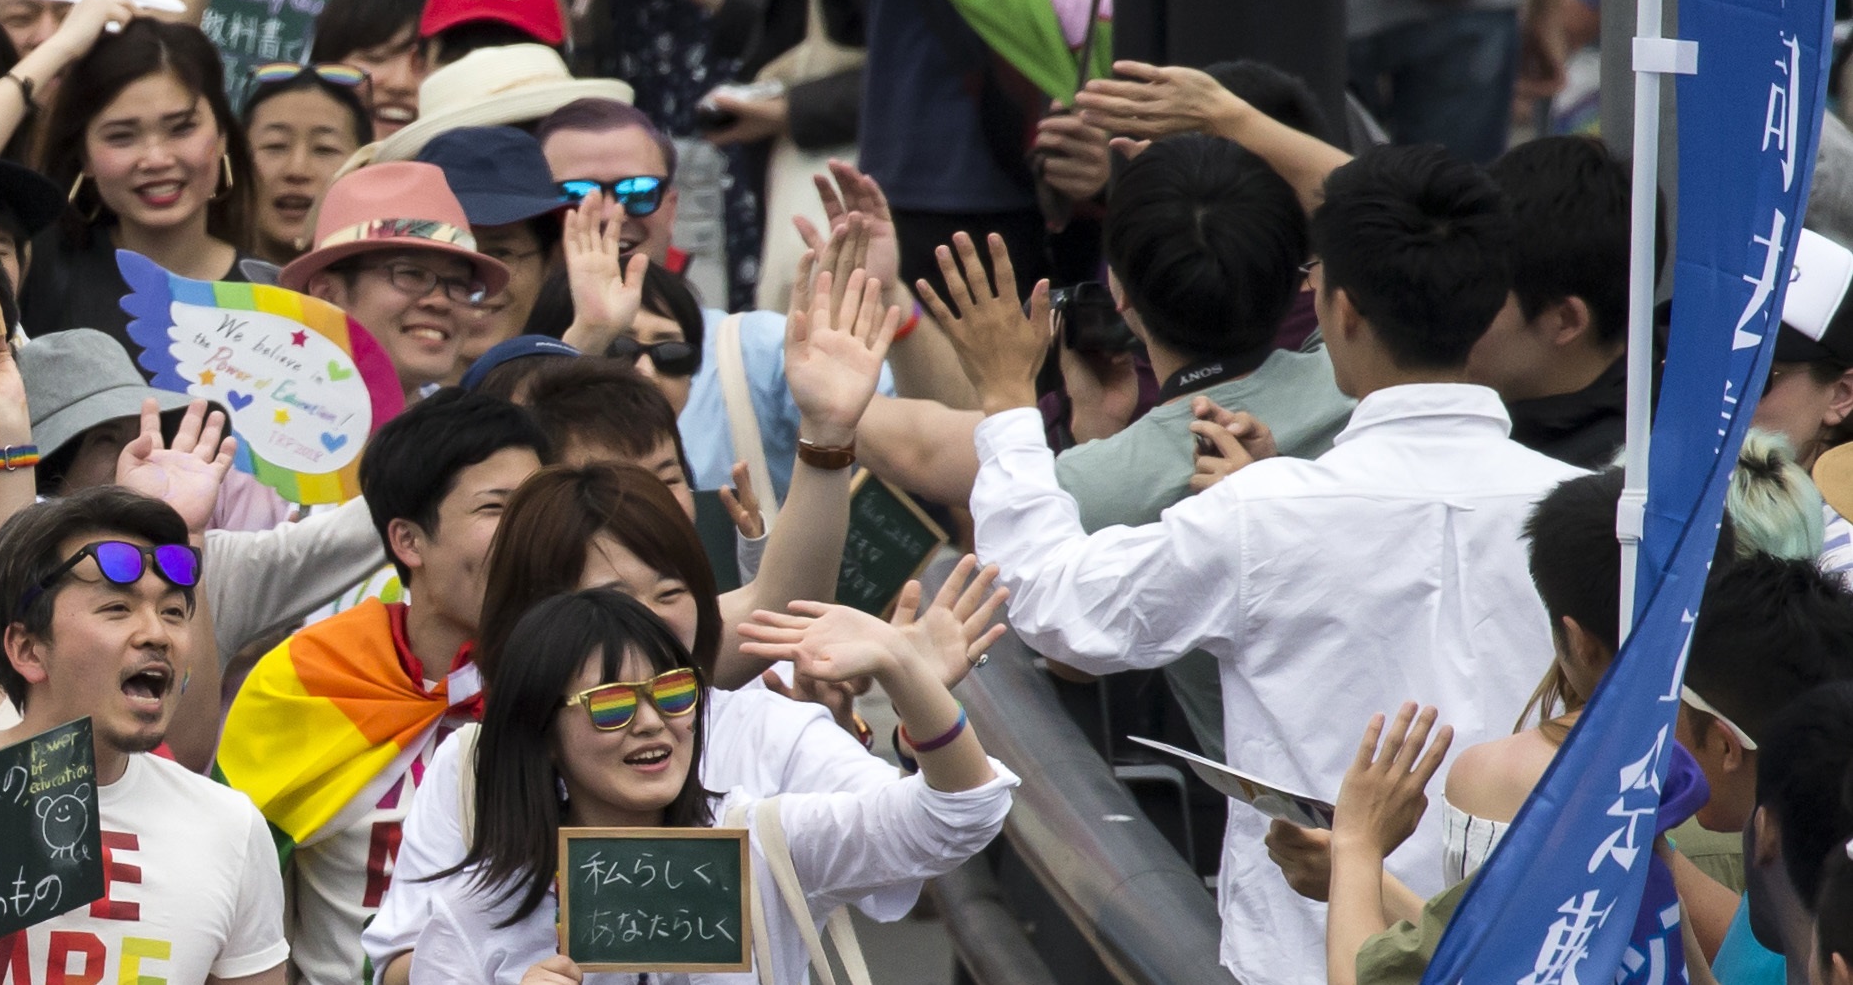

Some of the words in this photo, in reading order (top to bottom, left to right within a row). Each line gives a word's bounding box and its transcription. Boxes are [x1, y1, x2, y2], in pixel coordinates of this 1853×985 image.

[194, 332, 211, 349] the
[204, 346, 253, 381] Power
[217, 314, 250, 342] We
[252, 334, 303, 372] believe
[1179, 364, 1223, 387] SONY
[581, 909, 736, 947] あなたらしく
